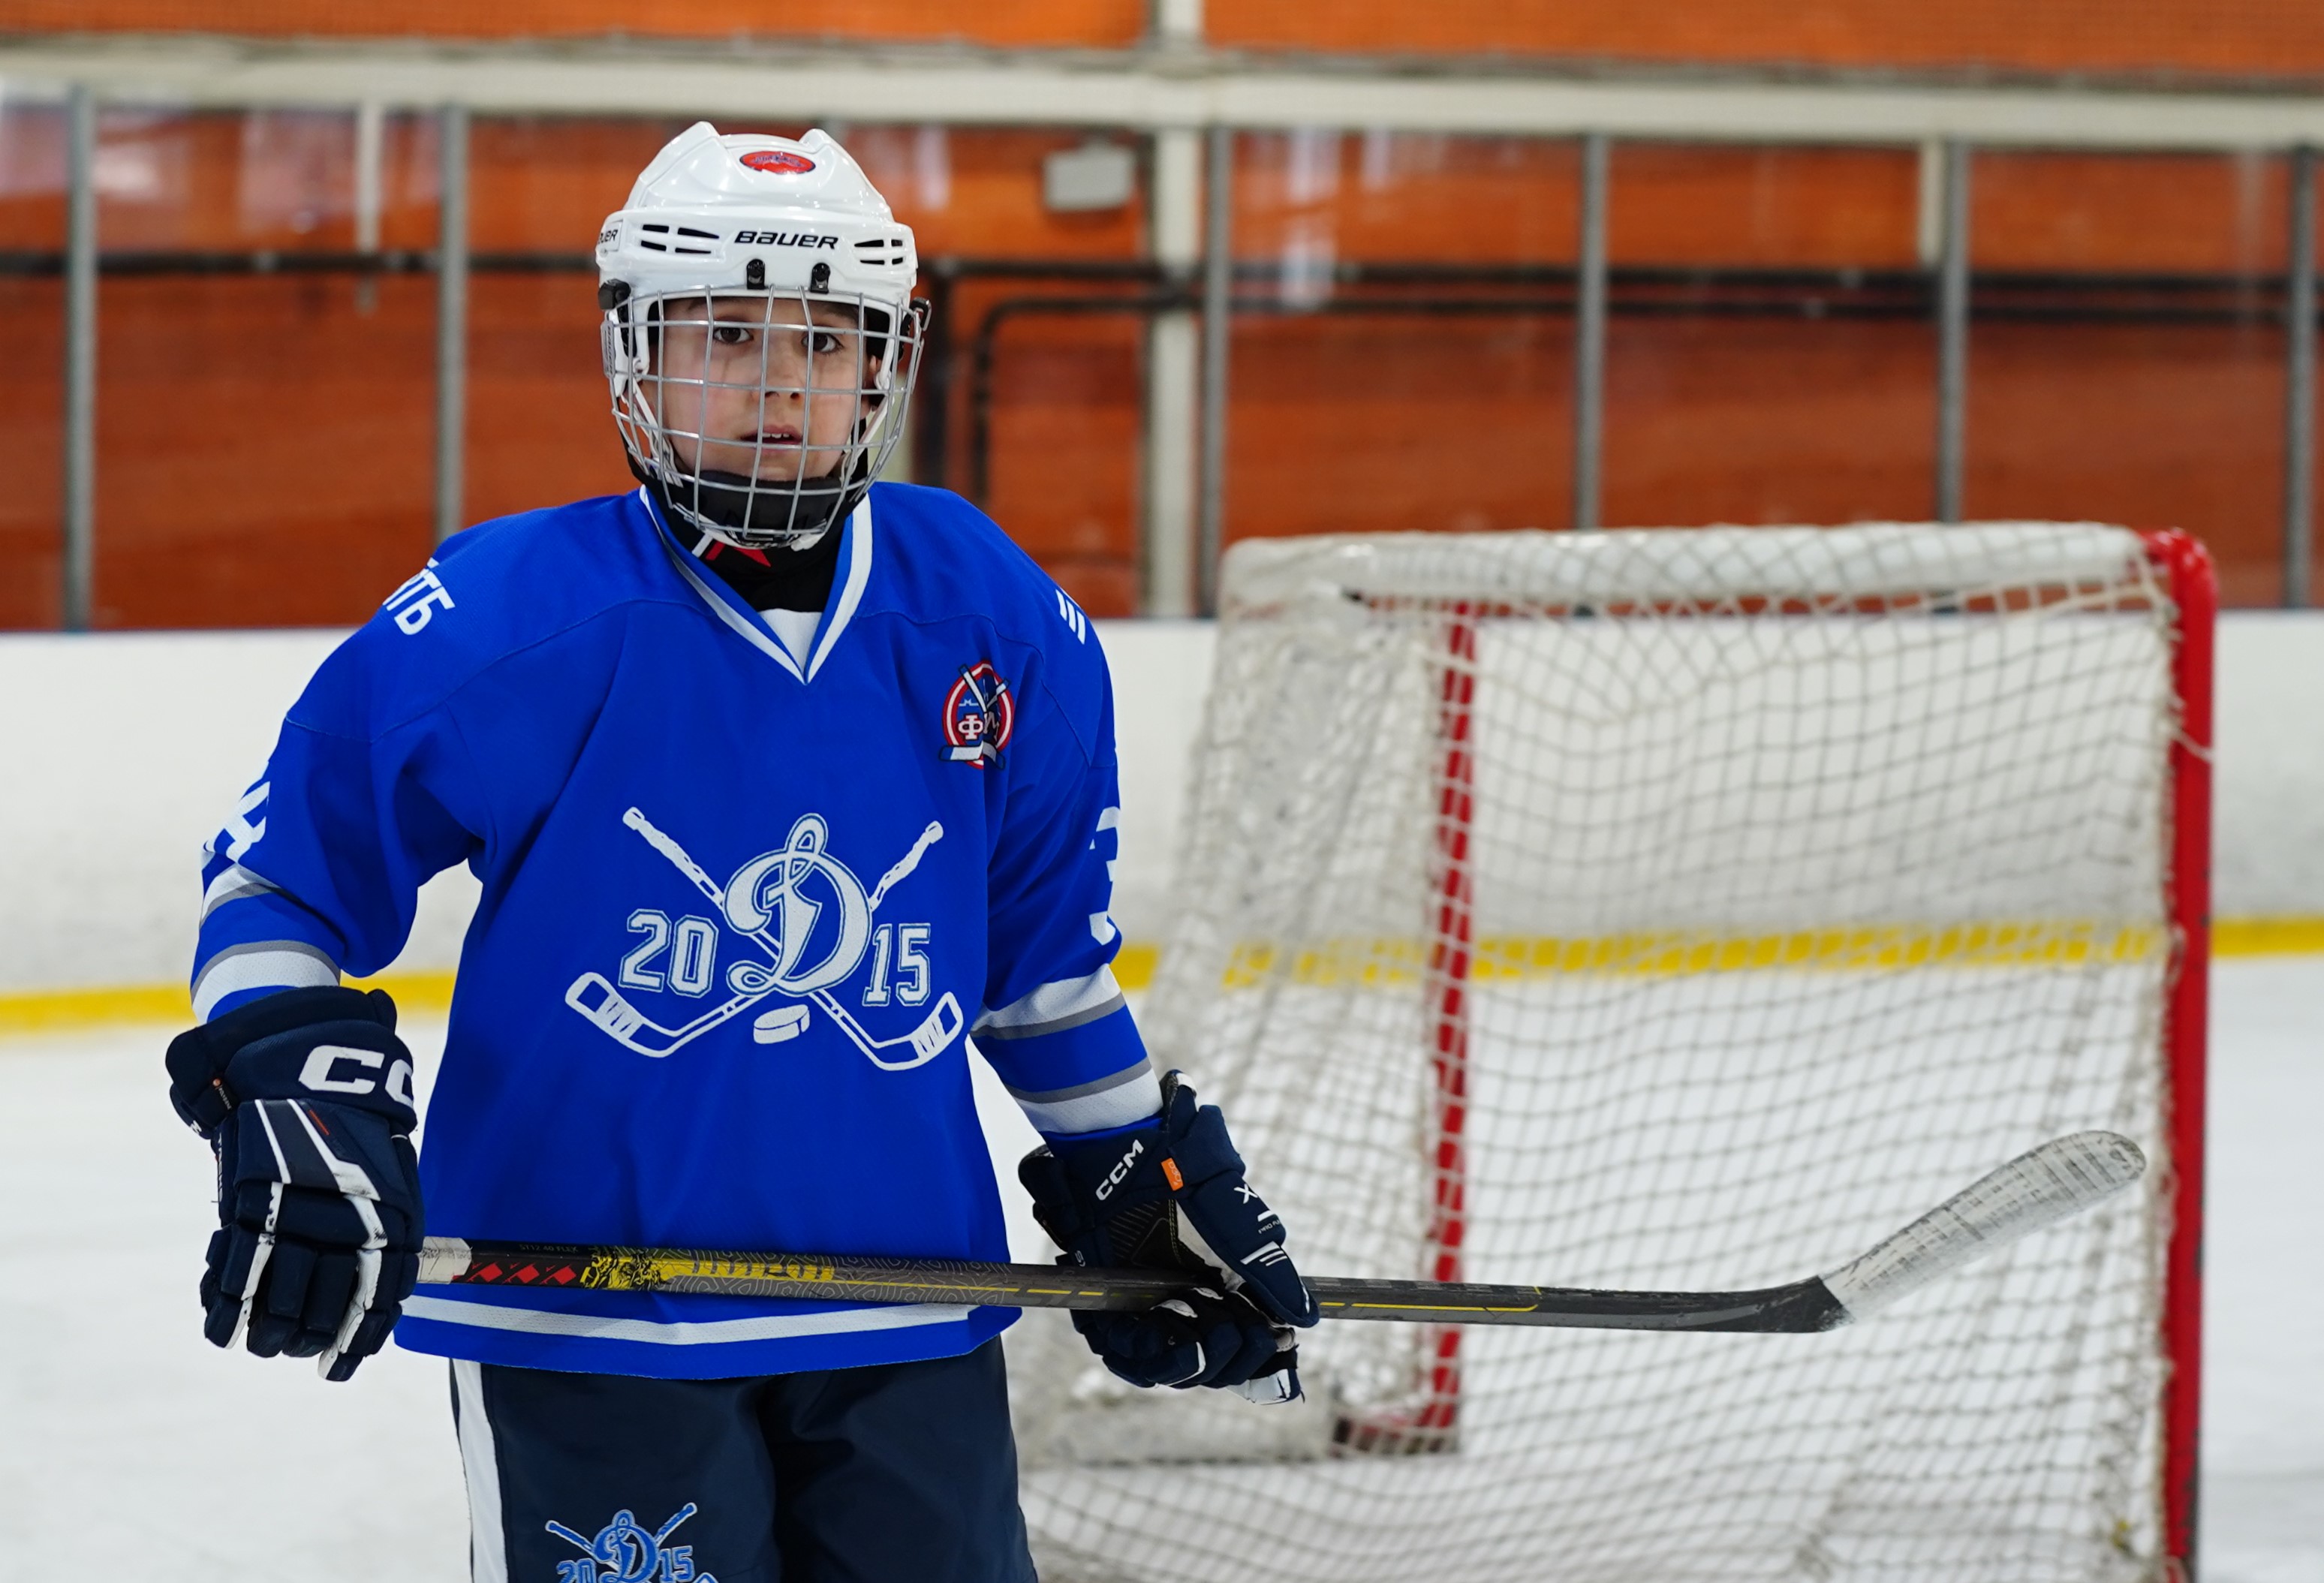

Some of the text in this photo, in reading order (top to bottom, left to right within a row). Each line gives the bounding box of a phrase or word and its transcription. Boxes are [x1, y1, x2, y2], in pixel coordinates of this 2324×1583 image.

[734, 230, 838, 250] BAUER
[618, 909, 719, 998] 20
[862, 923, 931, 1007] 15
[299, 1045, 414, 1109] CC
[1095, 1139, 1144, 1201] CCM
[658, 1545, 695, 1583] 15
